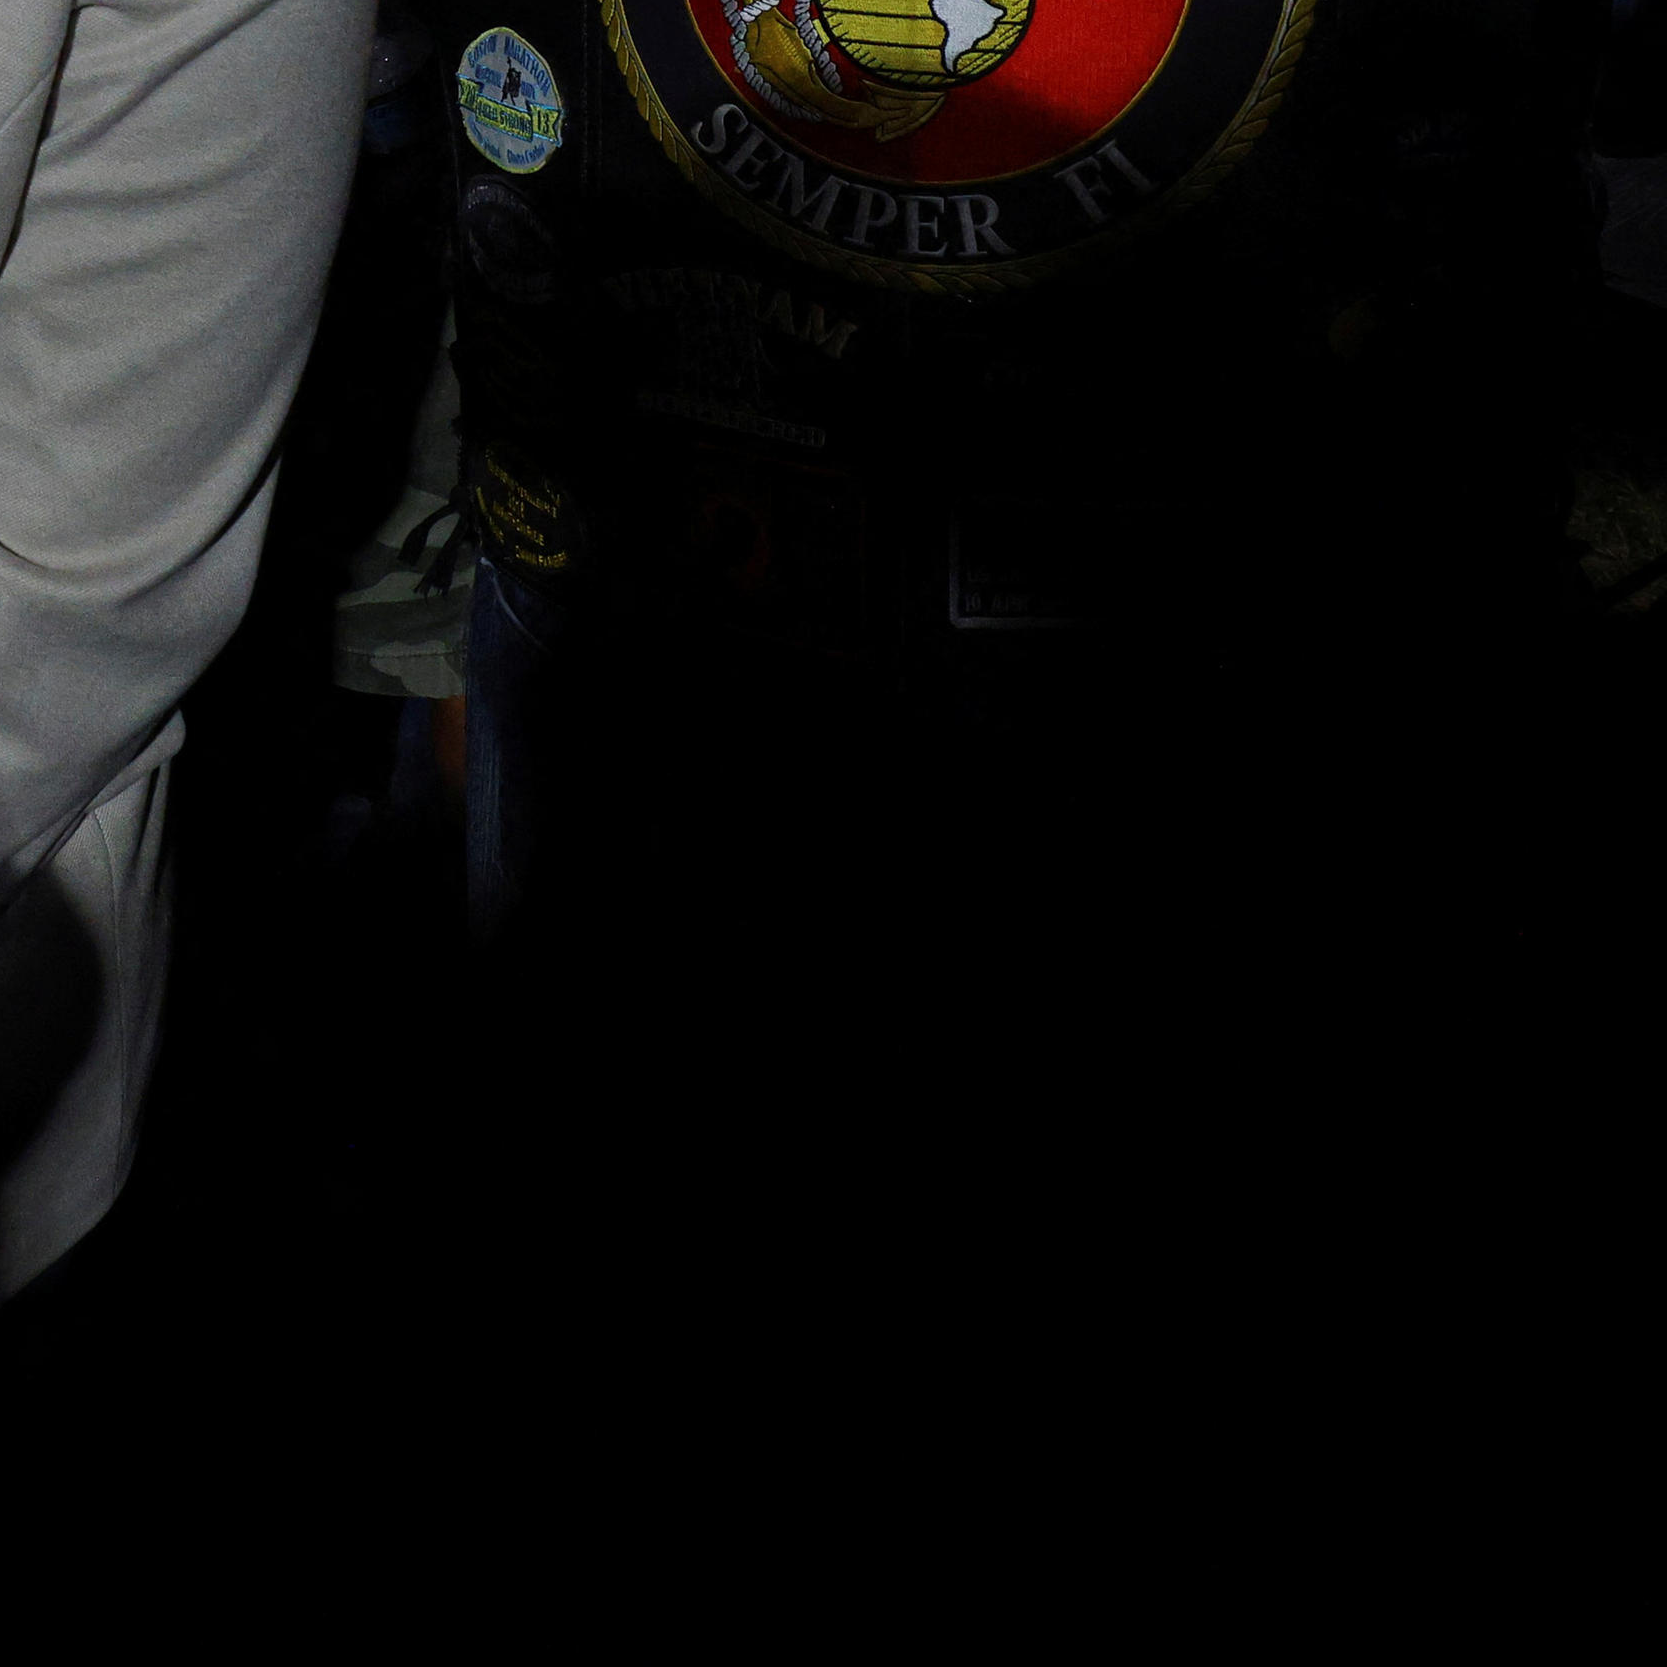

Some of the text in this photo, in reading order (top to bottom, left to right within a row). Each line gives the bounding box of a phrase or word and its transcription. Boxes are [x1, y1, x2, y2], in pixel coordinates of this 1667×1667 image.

[504, 36, 551, 97] MARATHON
[692, 102, 1156, 259] SEMPER FI
